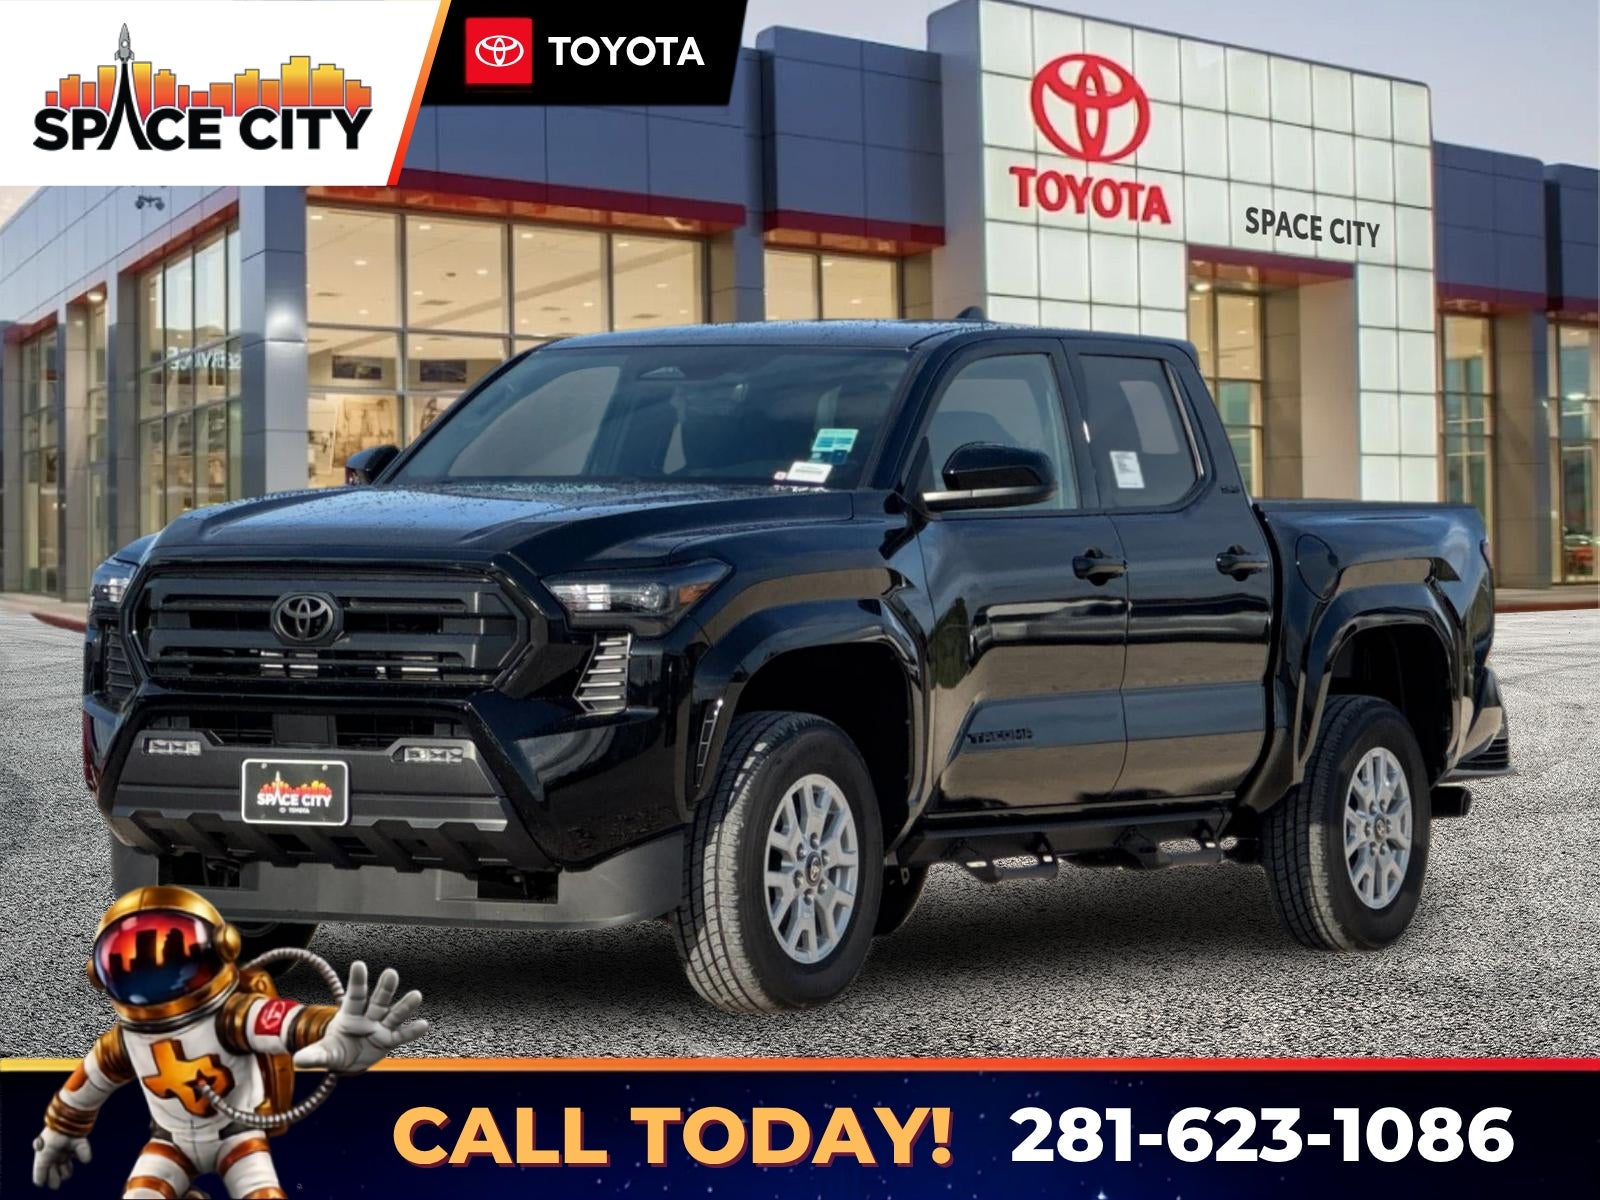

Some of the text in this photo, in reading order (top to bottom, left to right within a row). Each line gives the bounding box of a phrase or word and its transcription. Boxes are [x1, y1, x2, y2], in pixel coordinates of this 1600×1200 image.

[1009, 166, 1171, 224] TOYOTA
[1245, 207, 1380, 247] SPACE CITY
[257, 793, 332, 807] SPACE CITY
